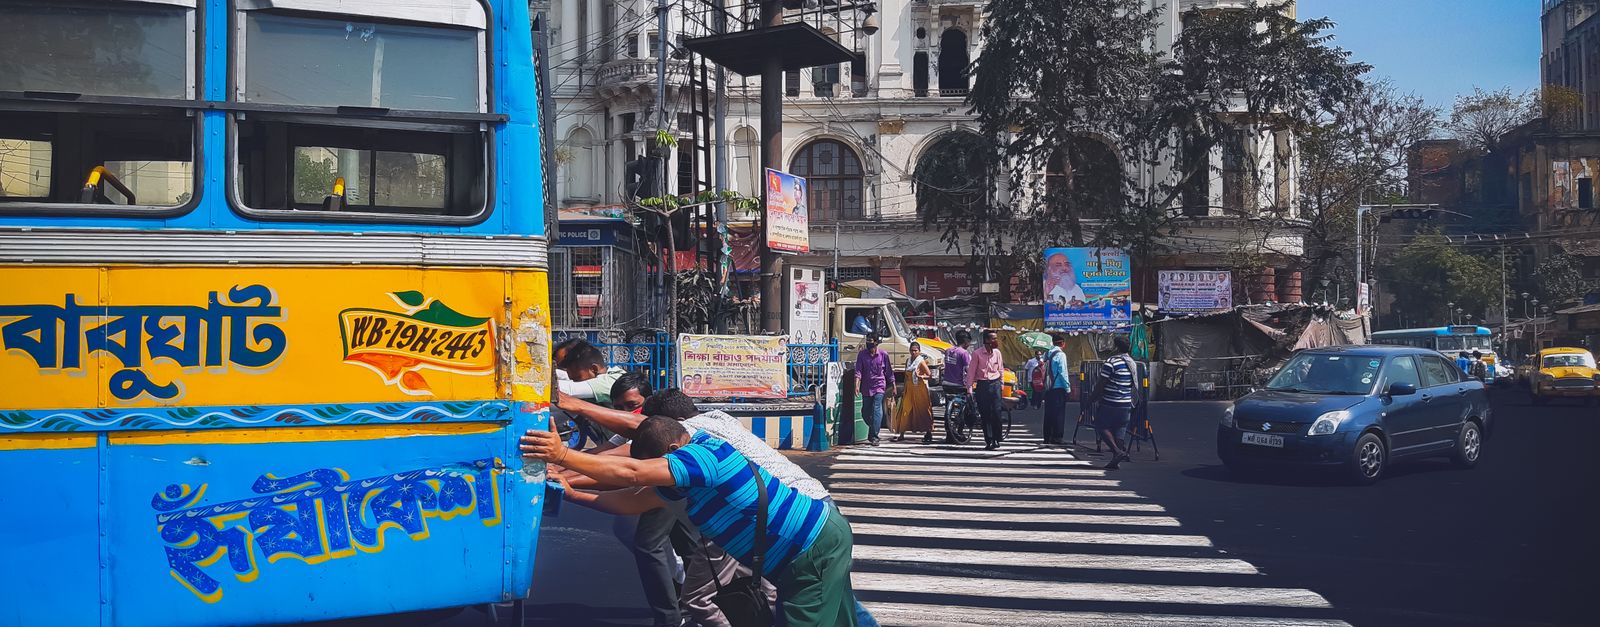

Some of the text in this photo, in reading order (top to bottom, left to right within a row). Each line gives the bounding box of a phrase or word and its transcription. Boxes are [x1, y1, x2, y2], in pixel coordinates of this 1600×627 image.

[0, 284, 287, 400] বাবুঘাট
[351, 315, 488, 360] WB-19H-2443
[684, 350, 784, 364] শিক্ষা বাঁচাও পদযাত্রা
